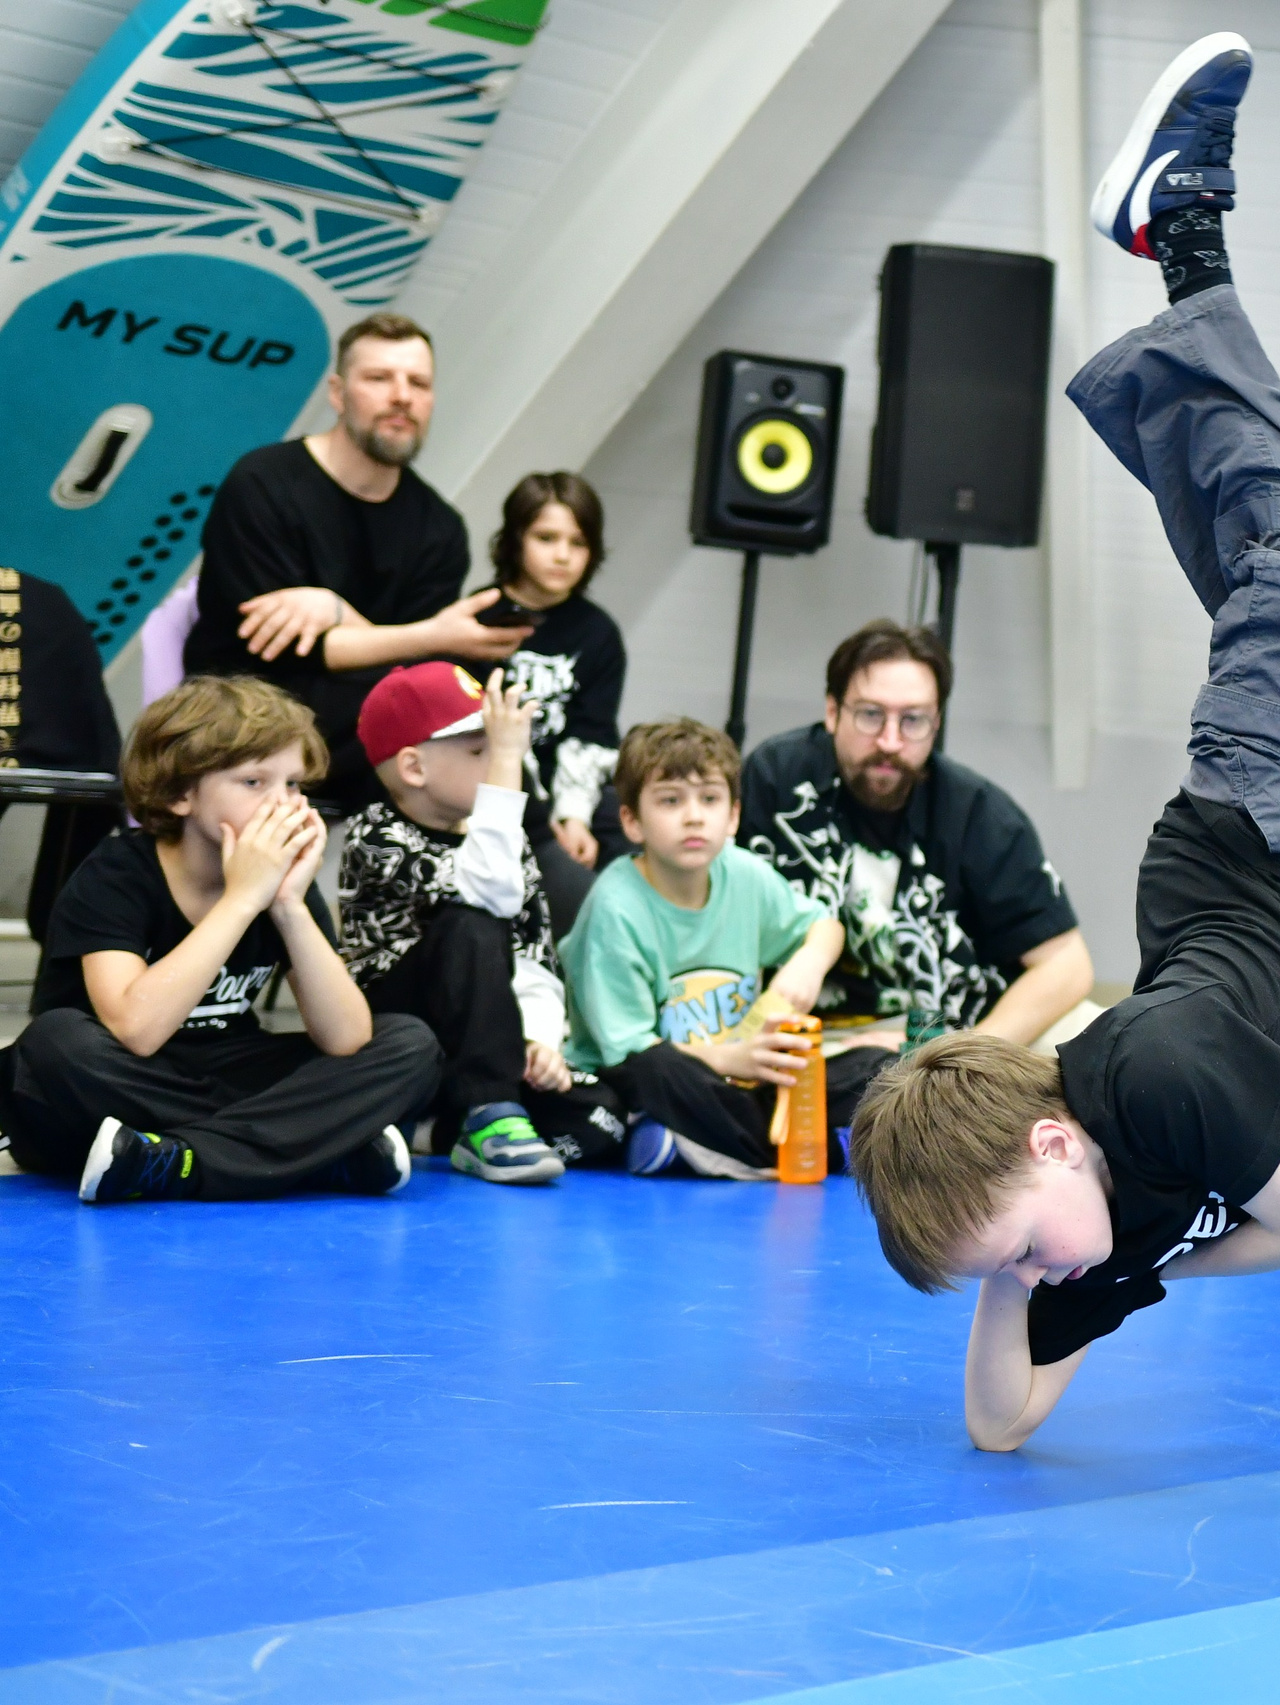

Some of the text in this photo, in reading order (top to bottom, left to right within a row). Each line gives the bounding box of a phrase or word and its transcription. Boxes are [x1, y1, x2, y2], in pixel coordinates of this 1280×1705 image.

[1165, 172, 1204, 186] FILA
[57, 299, 296, 370] MY SUP
